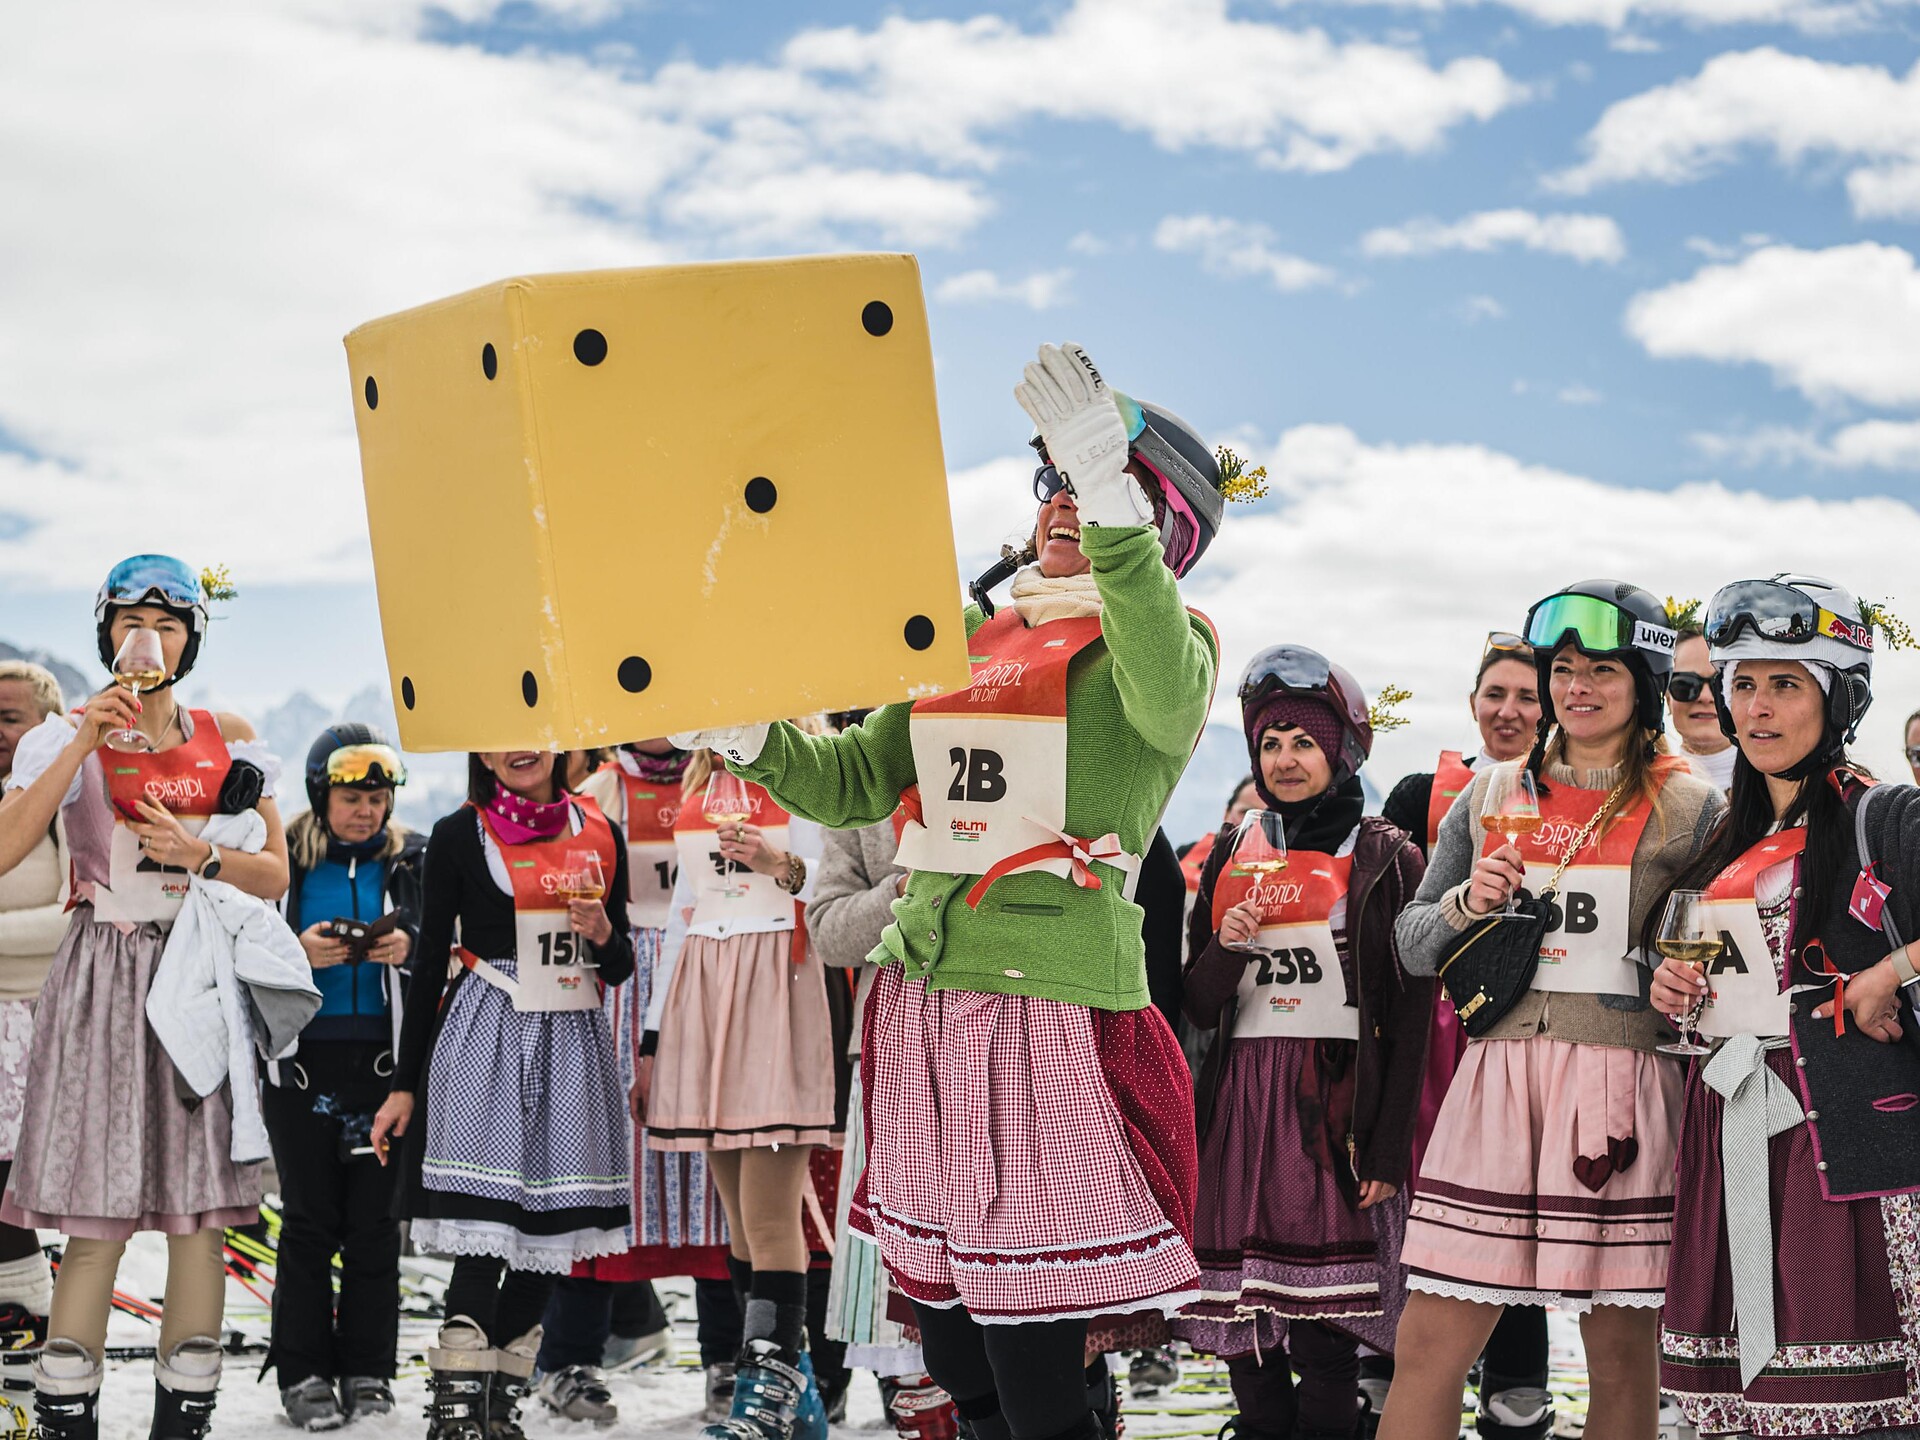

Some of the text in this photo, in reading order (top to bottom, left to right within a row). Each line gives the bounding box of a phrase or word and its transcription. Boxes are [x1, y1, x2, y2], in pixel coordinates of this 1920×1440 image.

[1075, 349, 1102, 389] LEVEL
[1641, 627, 1676, 649] uvex
[981, 687, 1002, 703] DAY
[947, 746, 1008, 803] 2B
[1247, 946, 1323, 987] 23B
